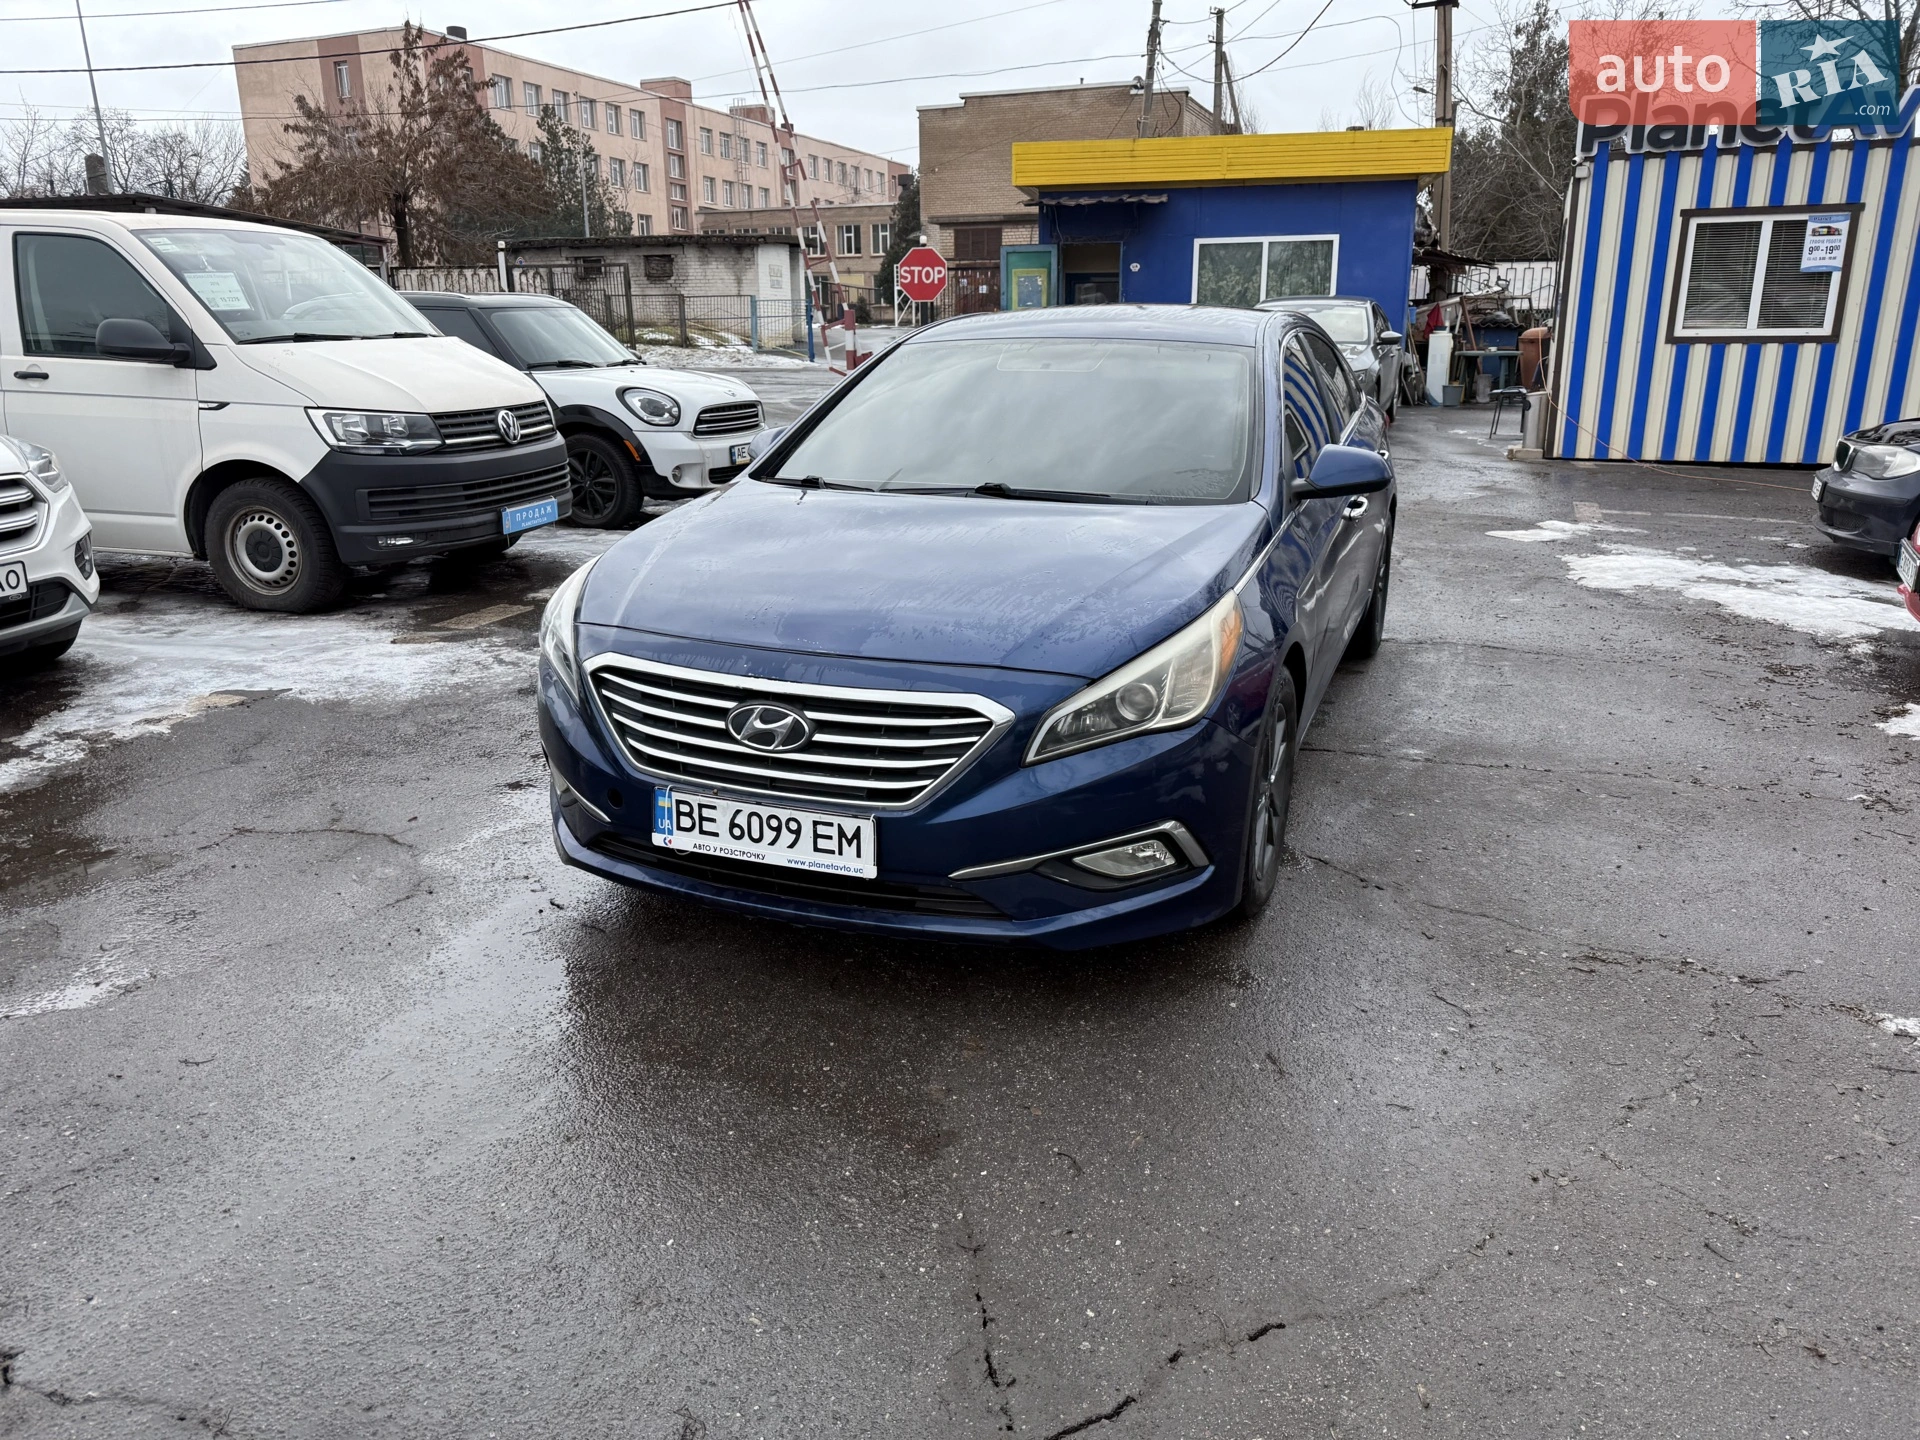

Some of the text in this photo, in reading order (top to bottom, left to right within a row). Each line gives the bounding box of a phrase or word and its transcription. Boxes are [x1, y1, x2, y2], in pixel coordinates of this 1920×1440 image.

[900, 266, 945, 284] STOP
[737, 446, 747, 459] AE
[515, 504, 552, 522] ПРОДАЖ
[658, 818, 672, 831] UA
[674, 799, 862, 859] BE 6099 EM
[692, 842, 766, 861] АВТО У РОЗСТРОЧКУ
